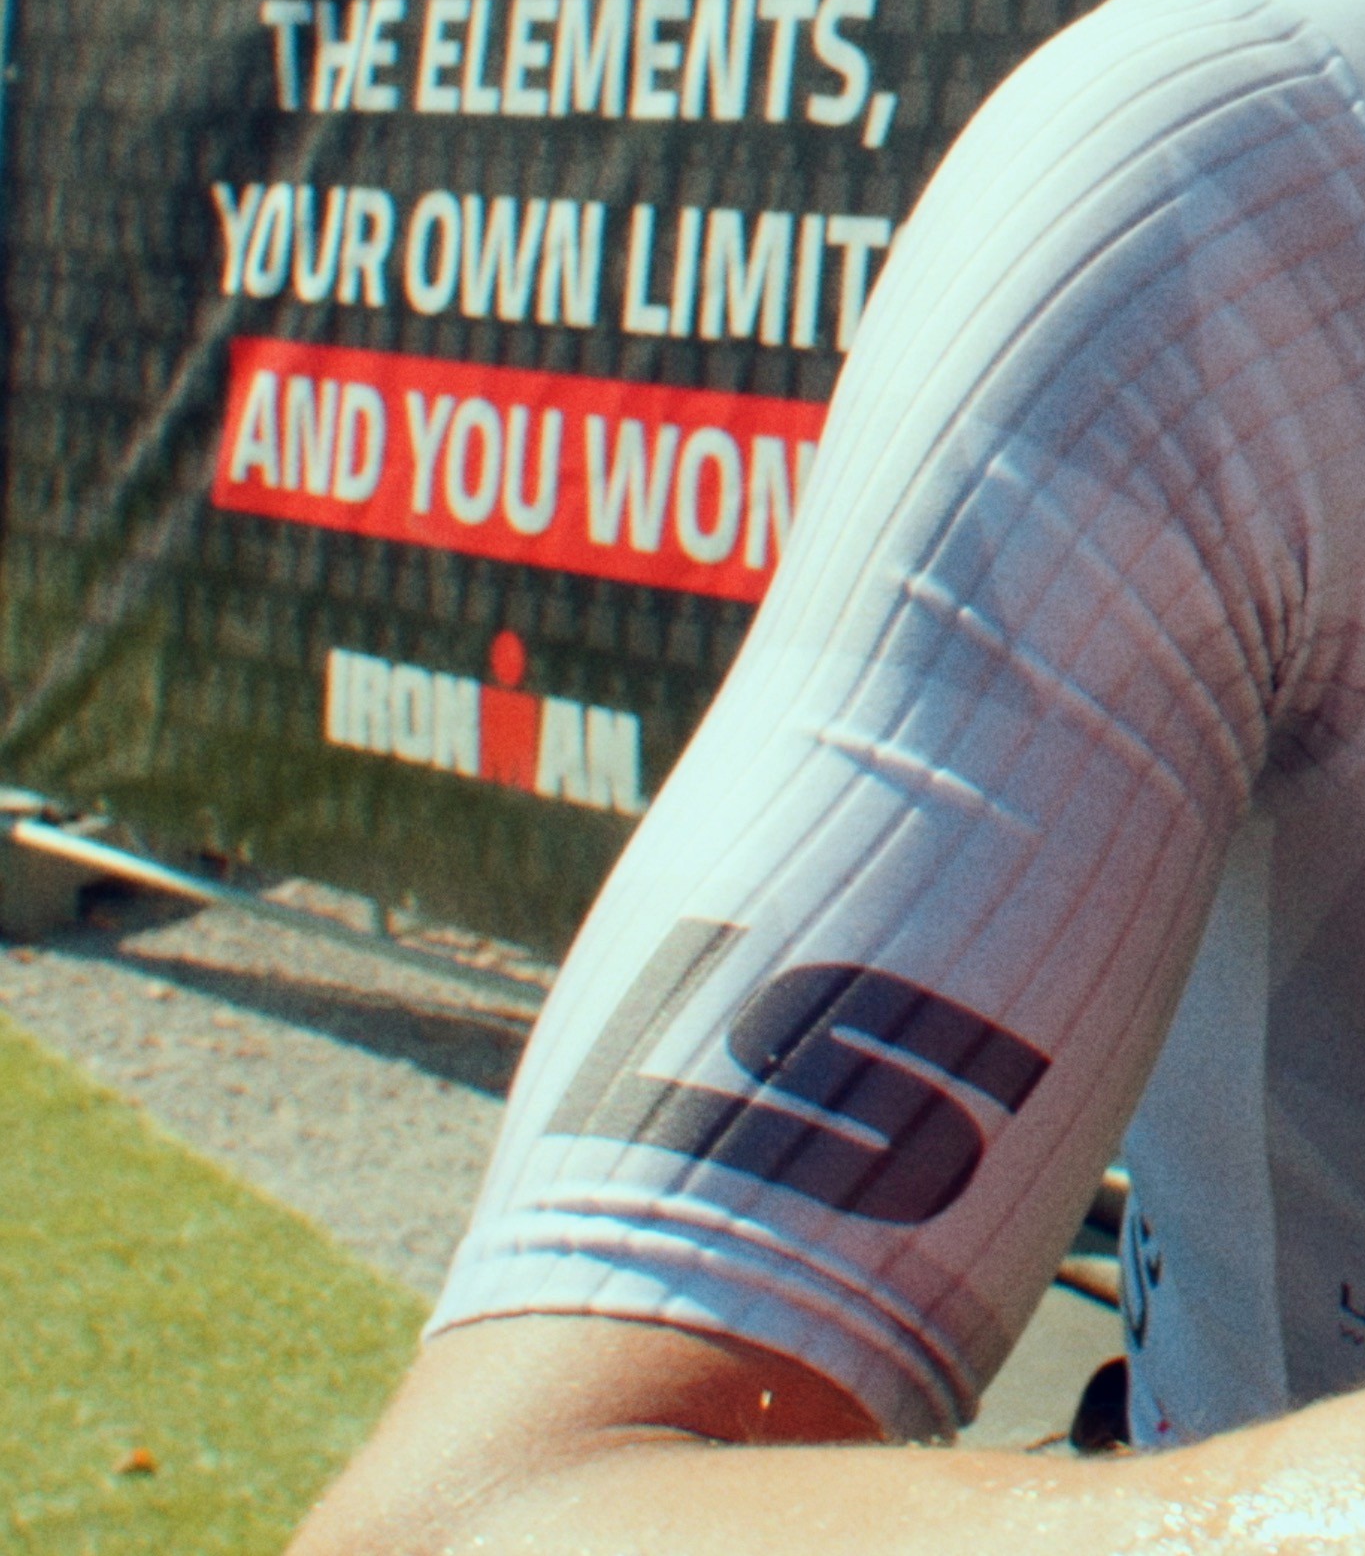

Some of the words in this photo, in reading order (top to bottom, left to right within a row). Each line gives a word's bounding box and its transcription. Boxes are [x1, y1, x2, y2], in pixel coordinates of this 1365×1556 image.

[213, 182, 393, 307] YOUR
[404, 191, 604, 329] OWN
[623, 202, 903, 352] LIMIT
[229, 370, 387, 504] AND
[406, 389, 563, 535] YOU
[325, 628, 644, 817] IRONMAN
